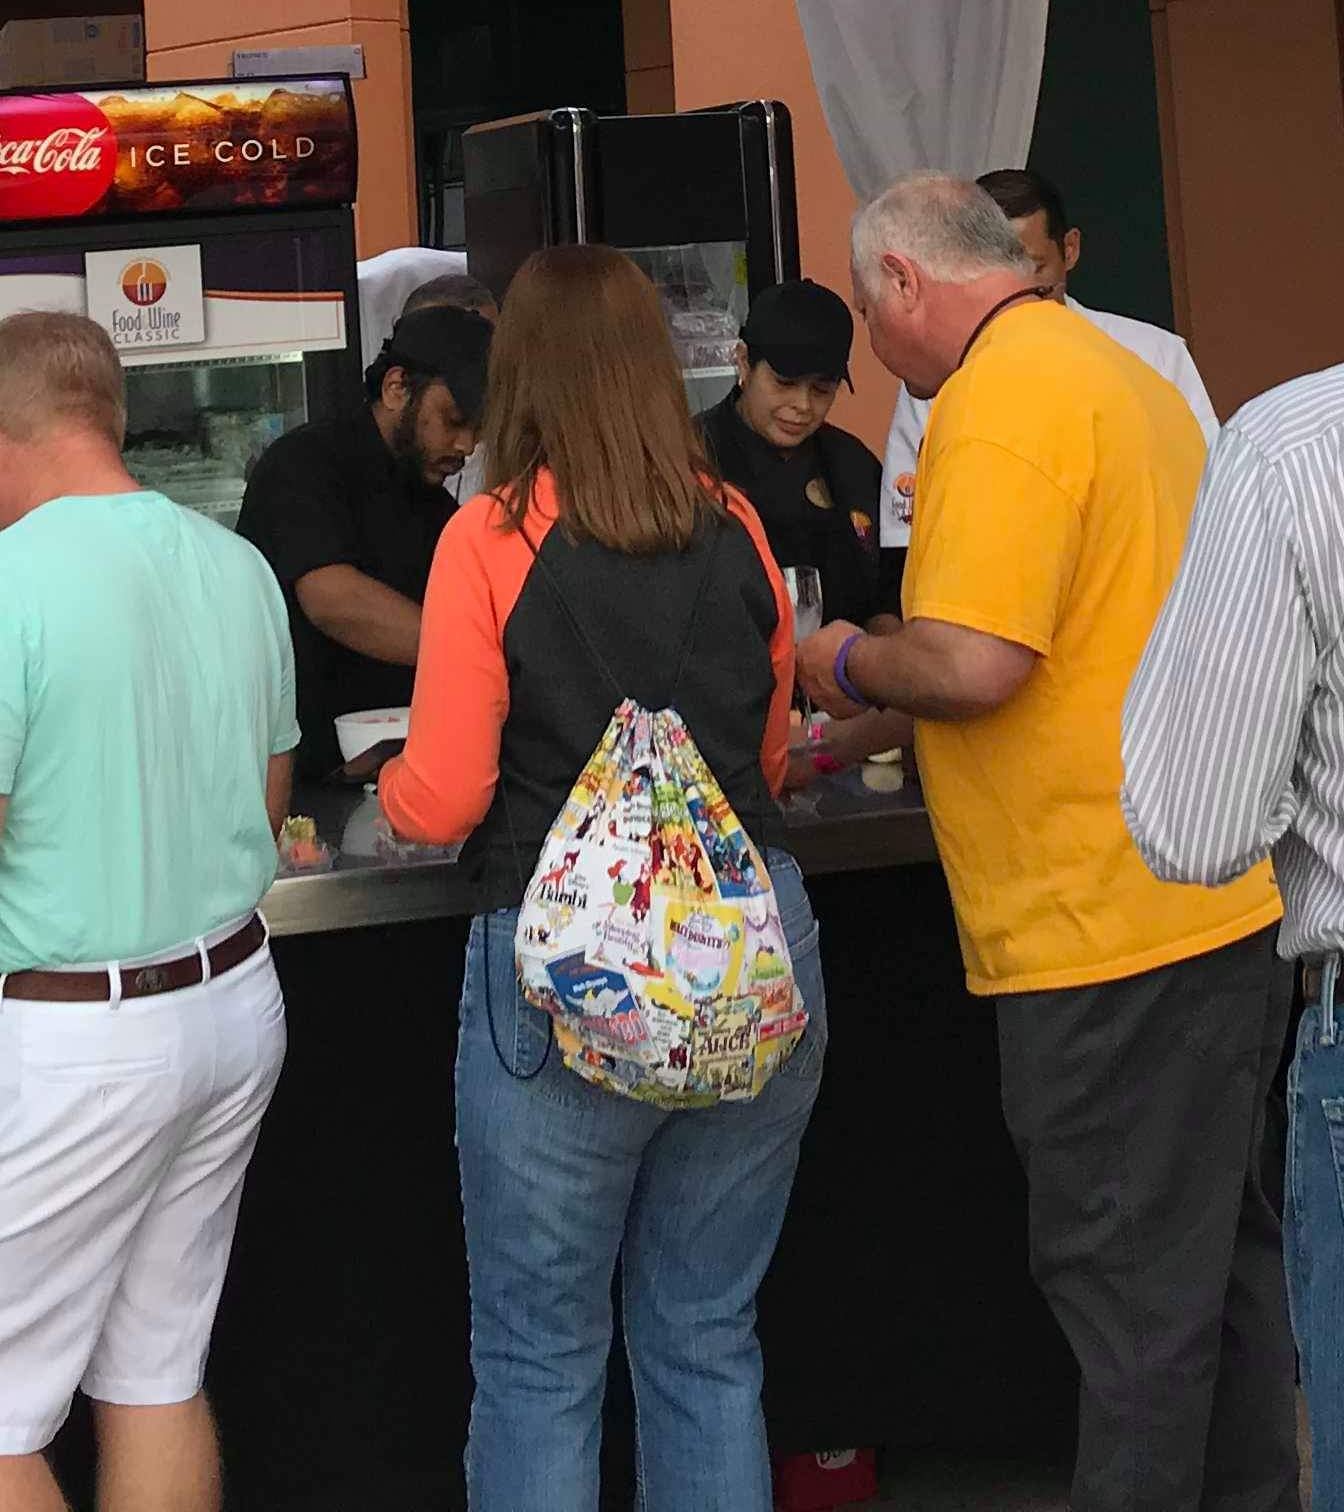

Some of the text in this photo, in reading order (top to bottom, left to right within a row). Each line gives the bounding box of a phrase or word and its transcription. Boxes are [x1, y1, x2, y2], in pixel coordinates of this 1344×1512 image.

[130, 137, 316, 168] ICE COLD
[112, 306, 182, 332] Food Wine
[113, 329, 181, 344] CLASSIC
